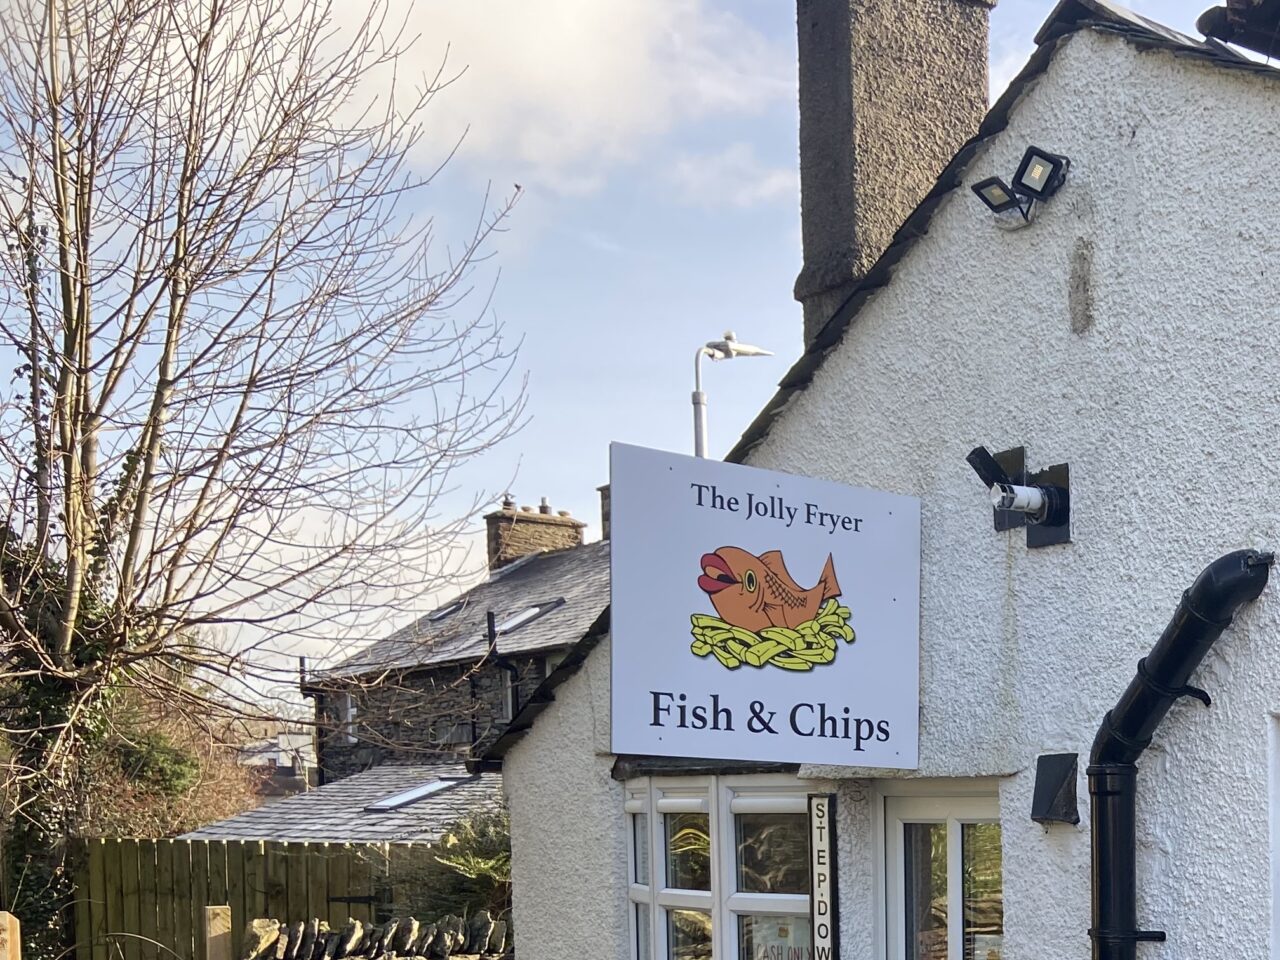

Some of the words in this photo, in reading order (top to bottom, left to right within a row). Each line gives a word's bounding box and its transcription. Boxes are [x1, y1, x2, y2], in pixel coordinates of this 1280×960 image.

[691, 483, 739, 512] The
[745, 493, 797, 527] Jolly
[804, 503, 863, 534] Fryer
[649, 691, 735, 731] Fish
[747, 700, 779, 734] &
[789, 703, 890, 751] Chips
